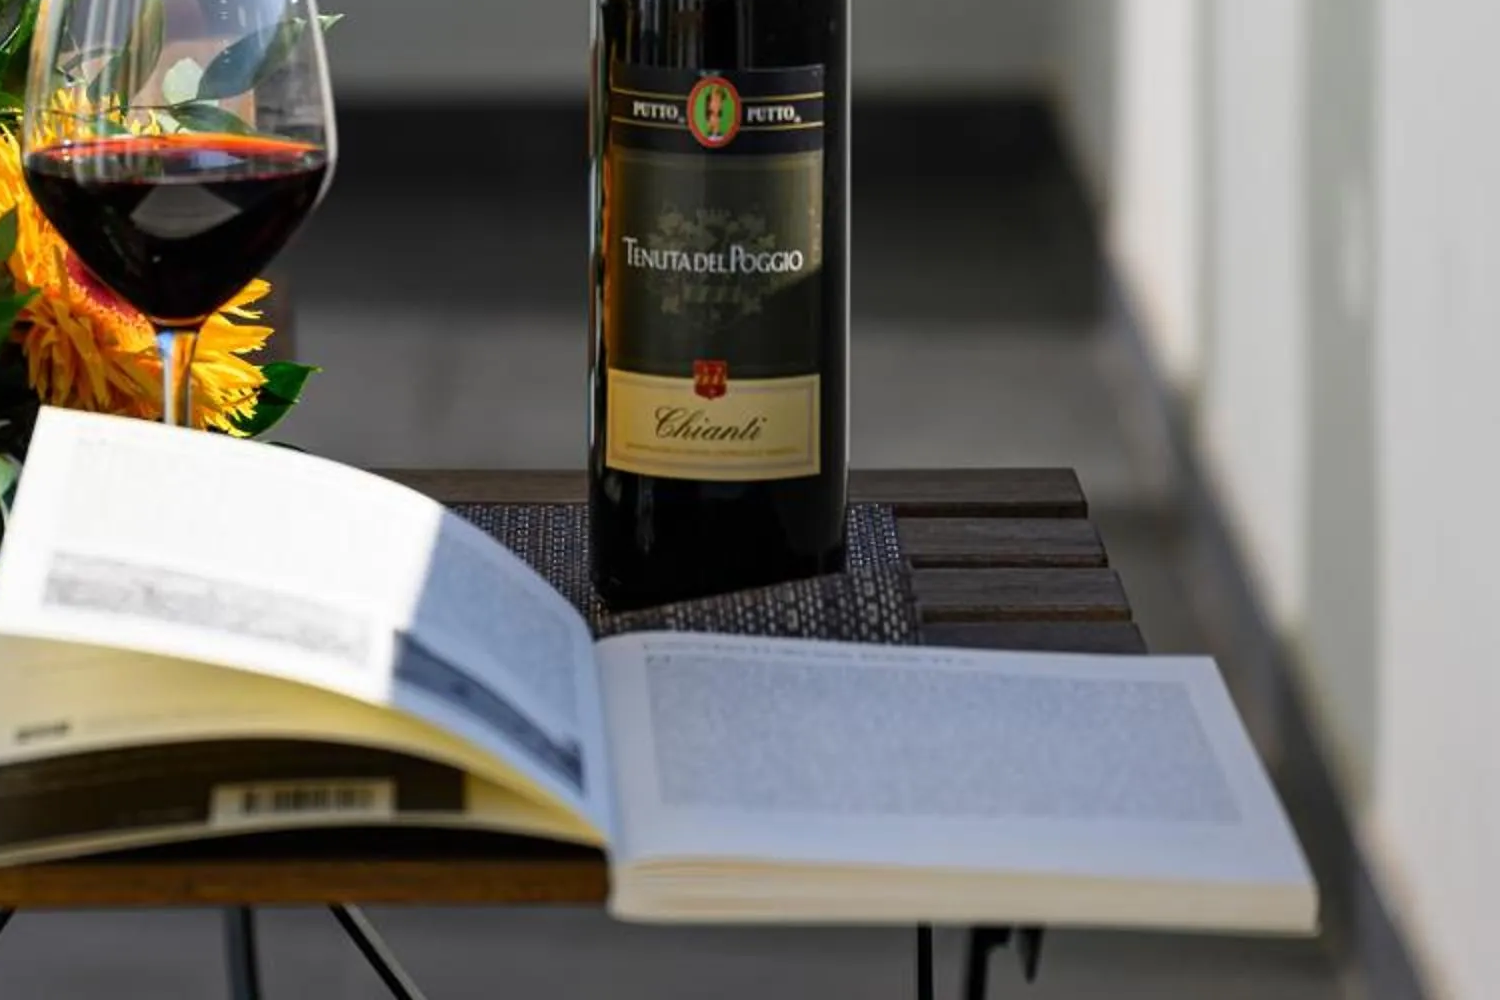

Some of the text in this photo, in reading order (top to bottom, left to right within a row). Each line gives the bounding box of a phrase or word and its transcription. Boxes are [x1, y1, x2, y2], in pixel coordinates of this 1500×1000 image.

[621, 236, 804, 273] TENUTA DEL POGGIO
[654, 406, 768, 441] Chianti
